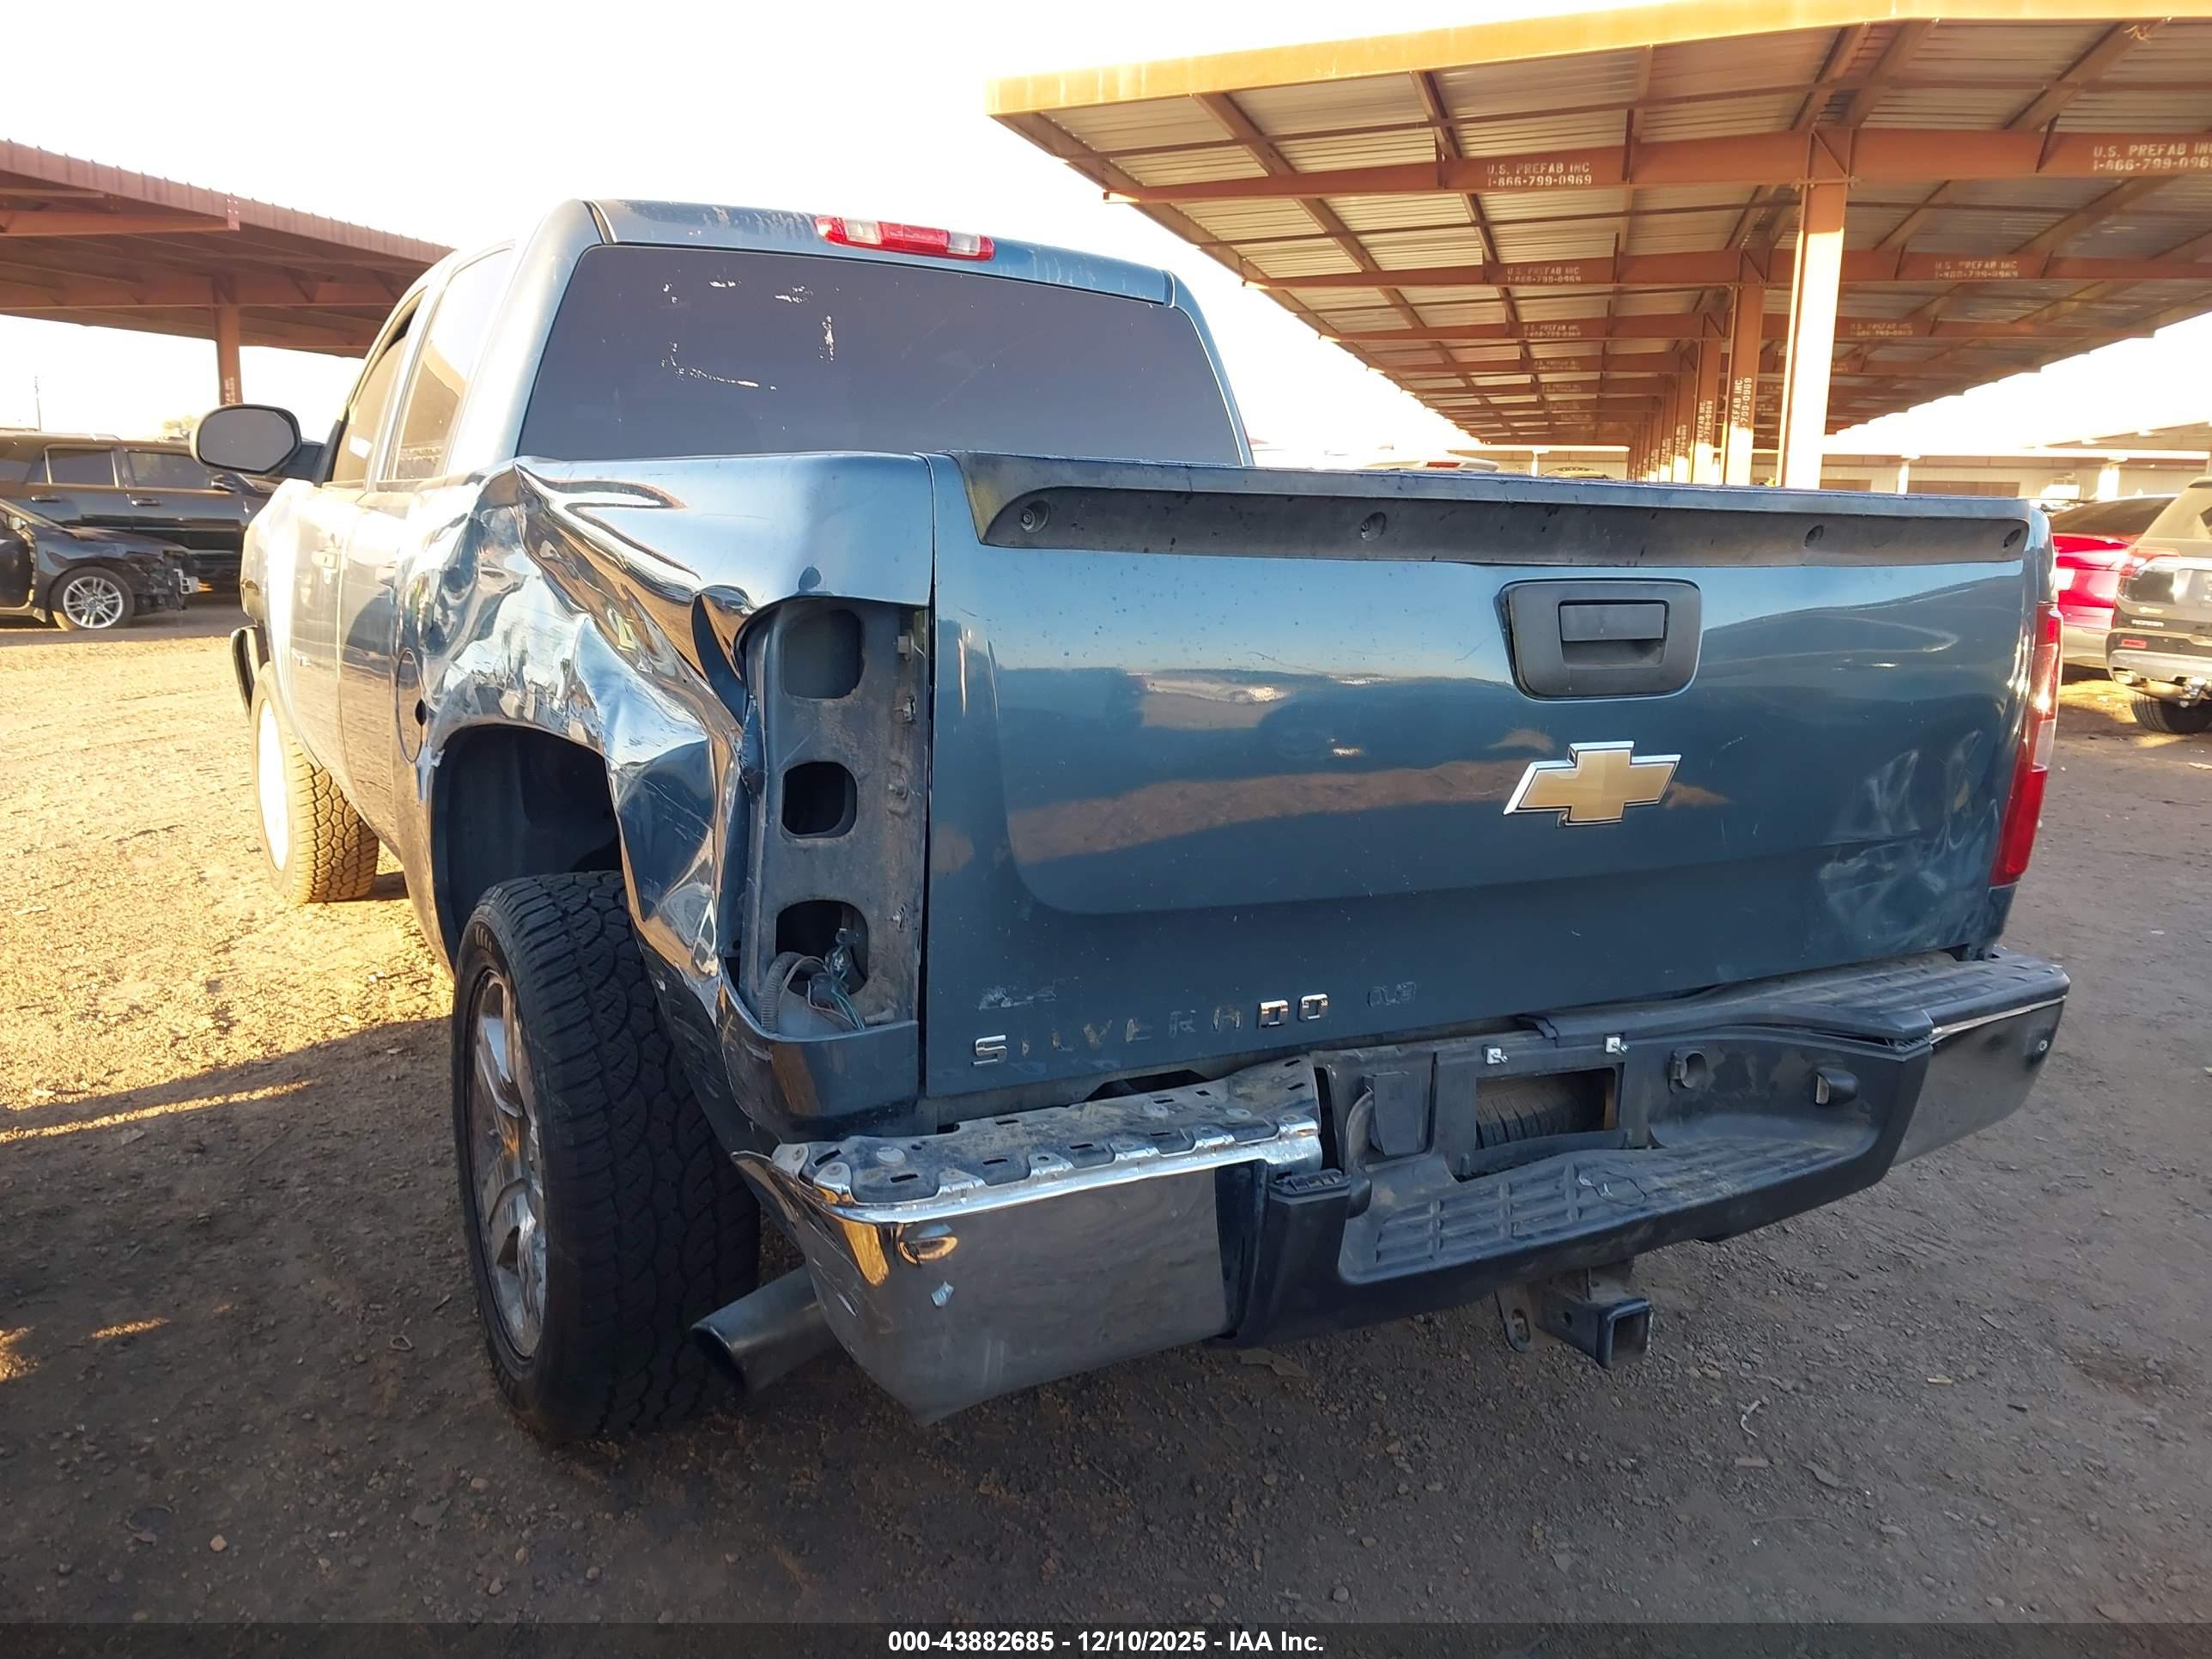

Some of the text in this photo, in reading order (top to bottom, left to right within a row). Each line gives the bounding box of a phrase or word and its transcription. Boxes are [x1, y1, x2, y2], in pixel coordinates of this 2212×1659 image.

[2094, 146, 2121, 158] U.S.
[2130, 143, 2187, 157] PREFAB
[1487, 163, 1510, 175] U.S.
[1516, 161, 1565, 175] PREFAB
[2093, 156, 2212, 171] 1-866-799-096
[1487, 174, 1592, 187] 1-866-799-0969
[1731, 398, 1742, 427] REFAB
